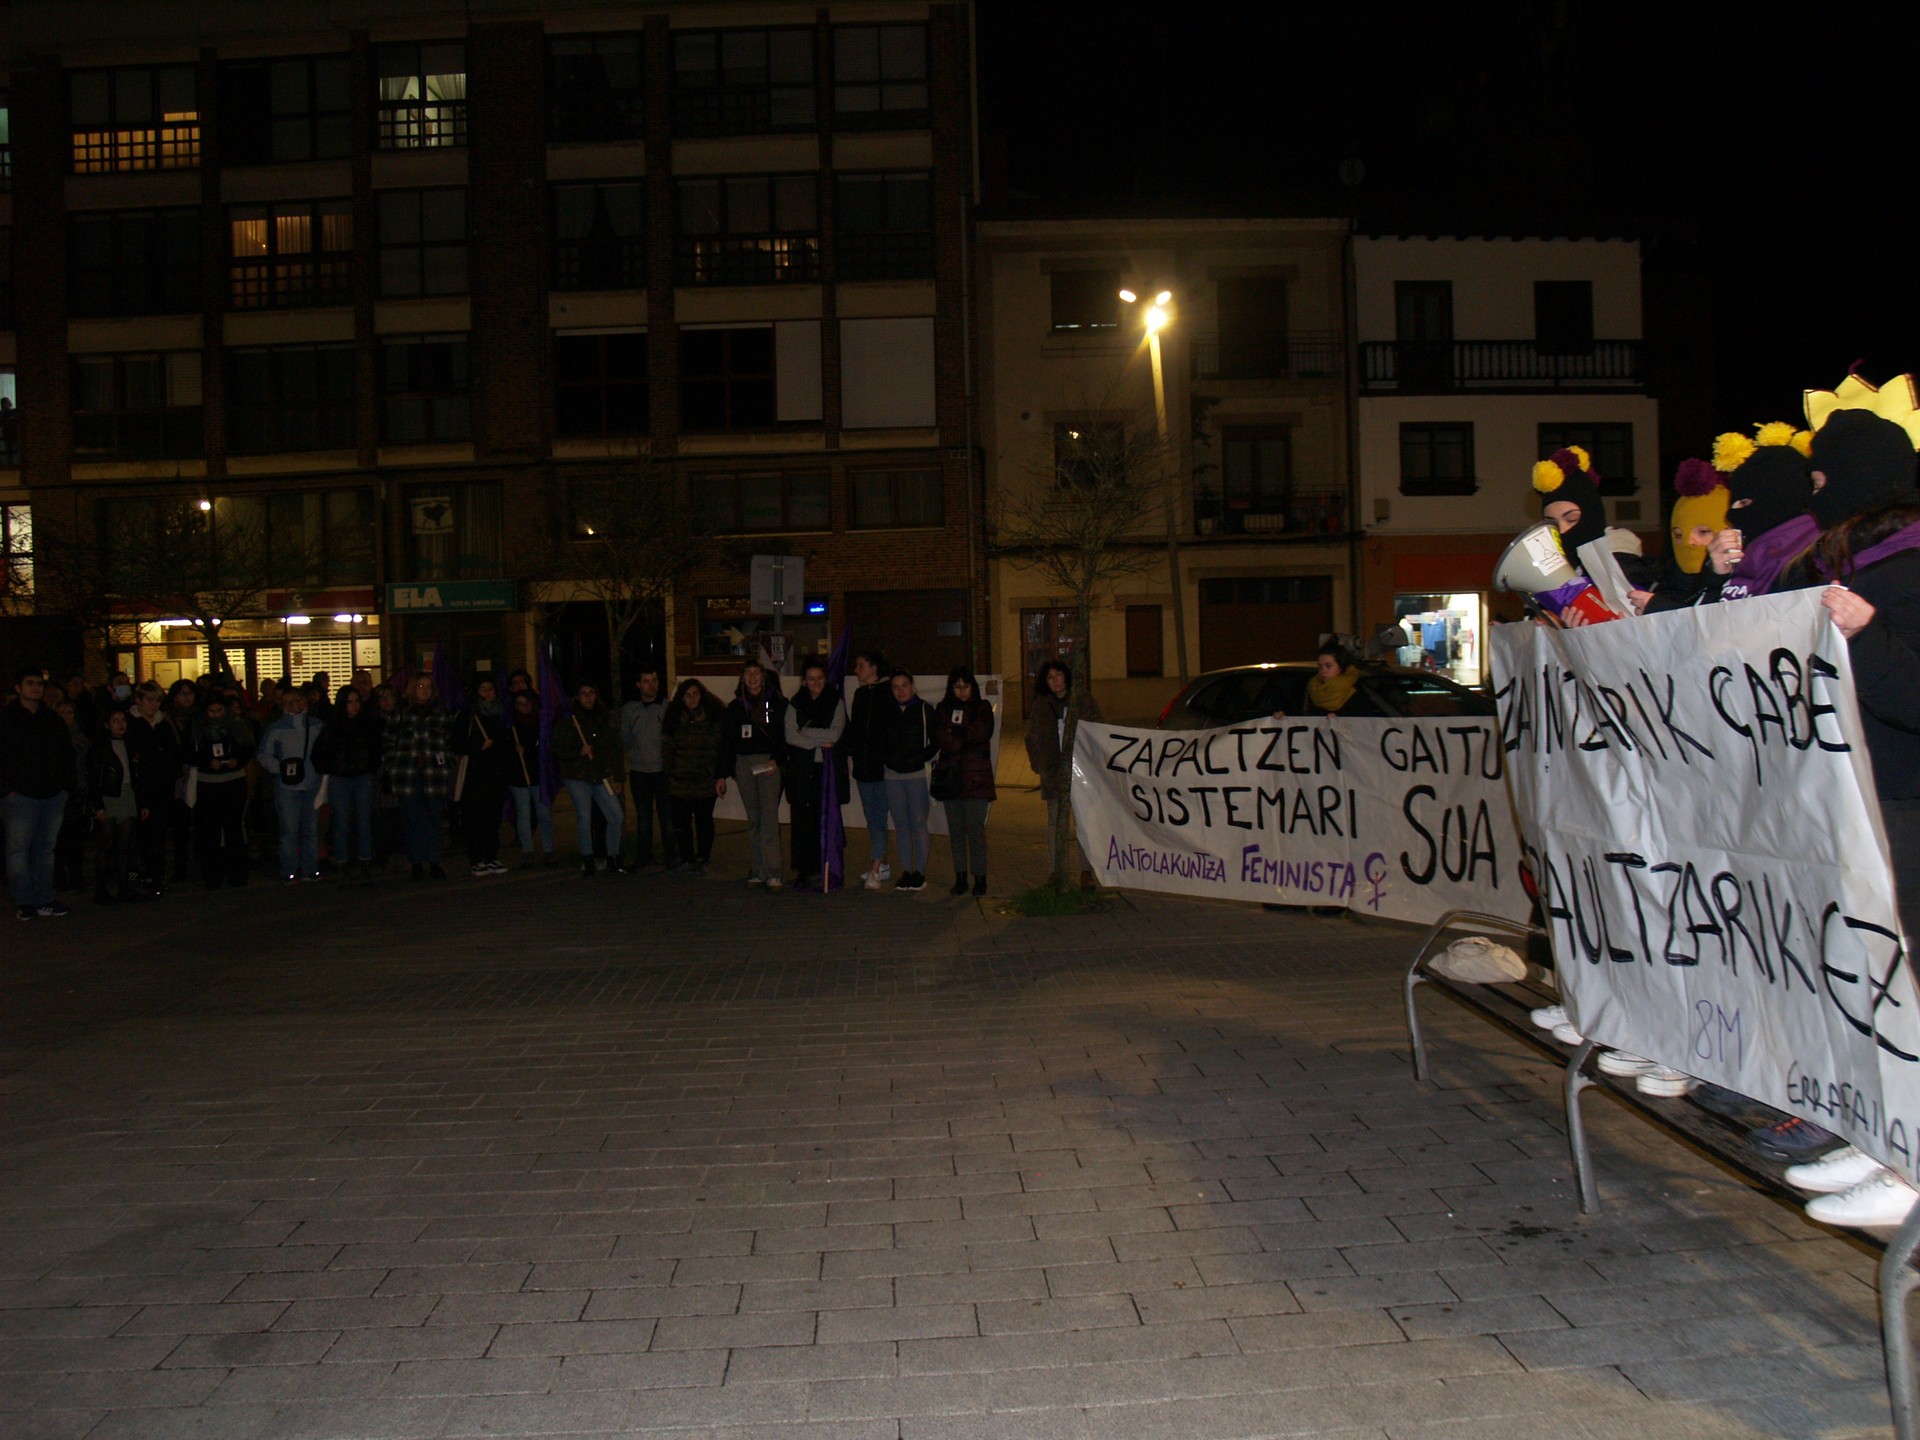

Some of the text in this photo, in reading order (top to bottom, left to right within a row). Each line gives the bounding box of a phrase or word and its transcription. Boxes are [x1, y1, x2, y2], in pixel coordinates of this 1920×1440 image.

[393, 587, 443, 609] ELA
[1106, 724, 1502, 780] ZAPALTZEN GAITU
[1106, 834, 1356, 898] ANTOLAKUNTZA FEMINISTA
[1131, 784, 1499, 890] SISTEMARI SUA
[1819, 901, 1919, 1062] EZ
[1695, 999, 1743, 1071] 8M
